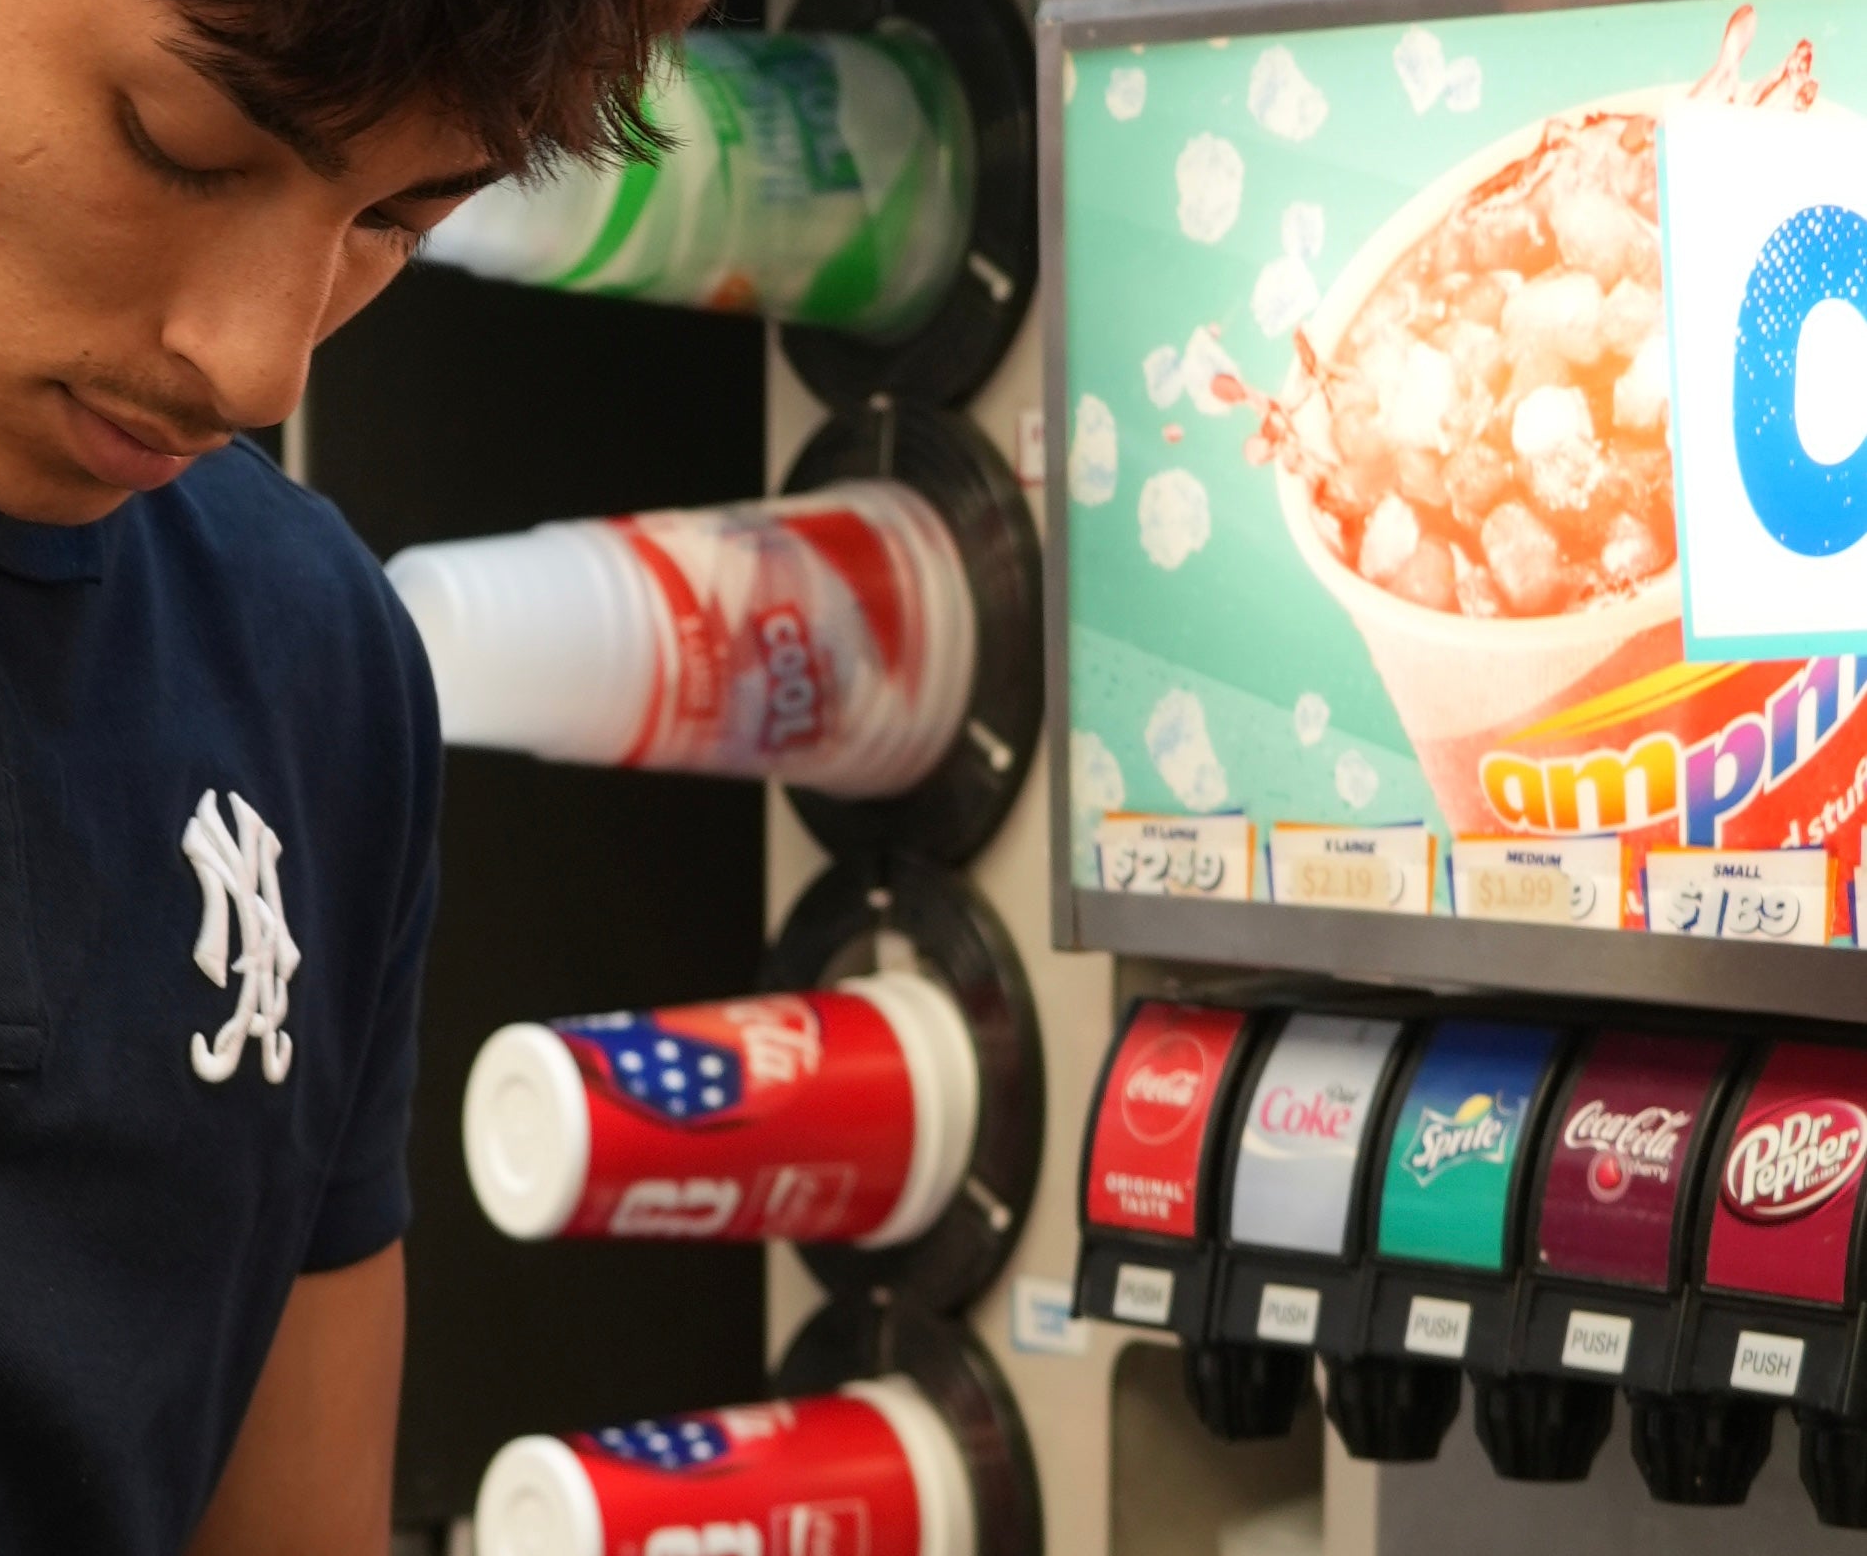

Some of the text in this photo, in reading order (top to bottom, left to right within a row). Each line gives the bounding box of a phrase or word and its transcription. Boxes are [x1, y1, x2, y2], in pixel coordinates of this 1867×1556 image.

[1334, 839, 1376, 855] LARGE
[1505, 849, 1562, 868] MEDIUM
[1301, 861, 1374, 899] $2.19
[1712, 862, 1762, 880] SMALL
[1479, 871, 1553, 909] $1.99
[1259, 1087, 1352, 1141] Coke
[1412, 1118, 1503, 1171] Sprite
[1778, 1111, 1833, 1159] Dr
[1729, 1124, 1861, 1206] Pepper
[1104, 1171, 1185, 1204] ORIGINAL
[1120, 1193, 1170, 1220] TASTE
[1264, 1301, 1310, 1328] PUSH
[1412, 1314, 1460, 1341] PUSH
[1571, 1327, 1620, 1355] PUSH
[1740, 1351, 1792, 1378] PUSH
